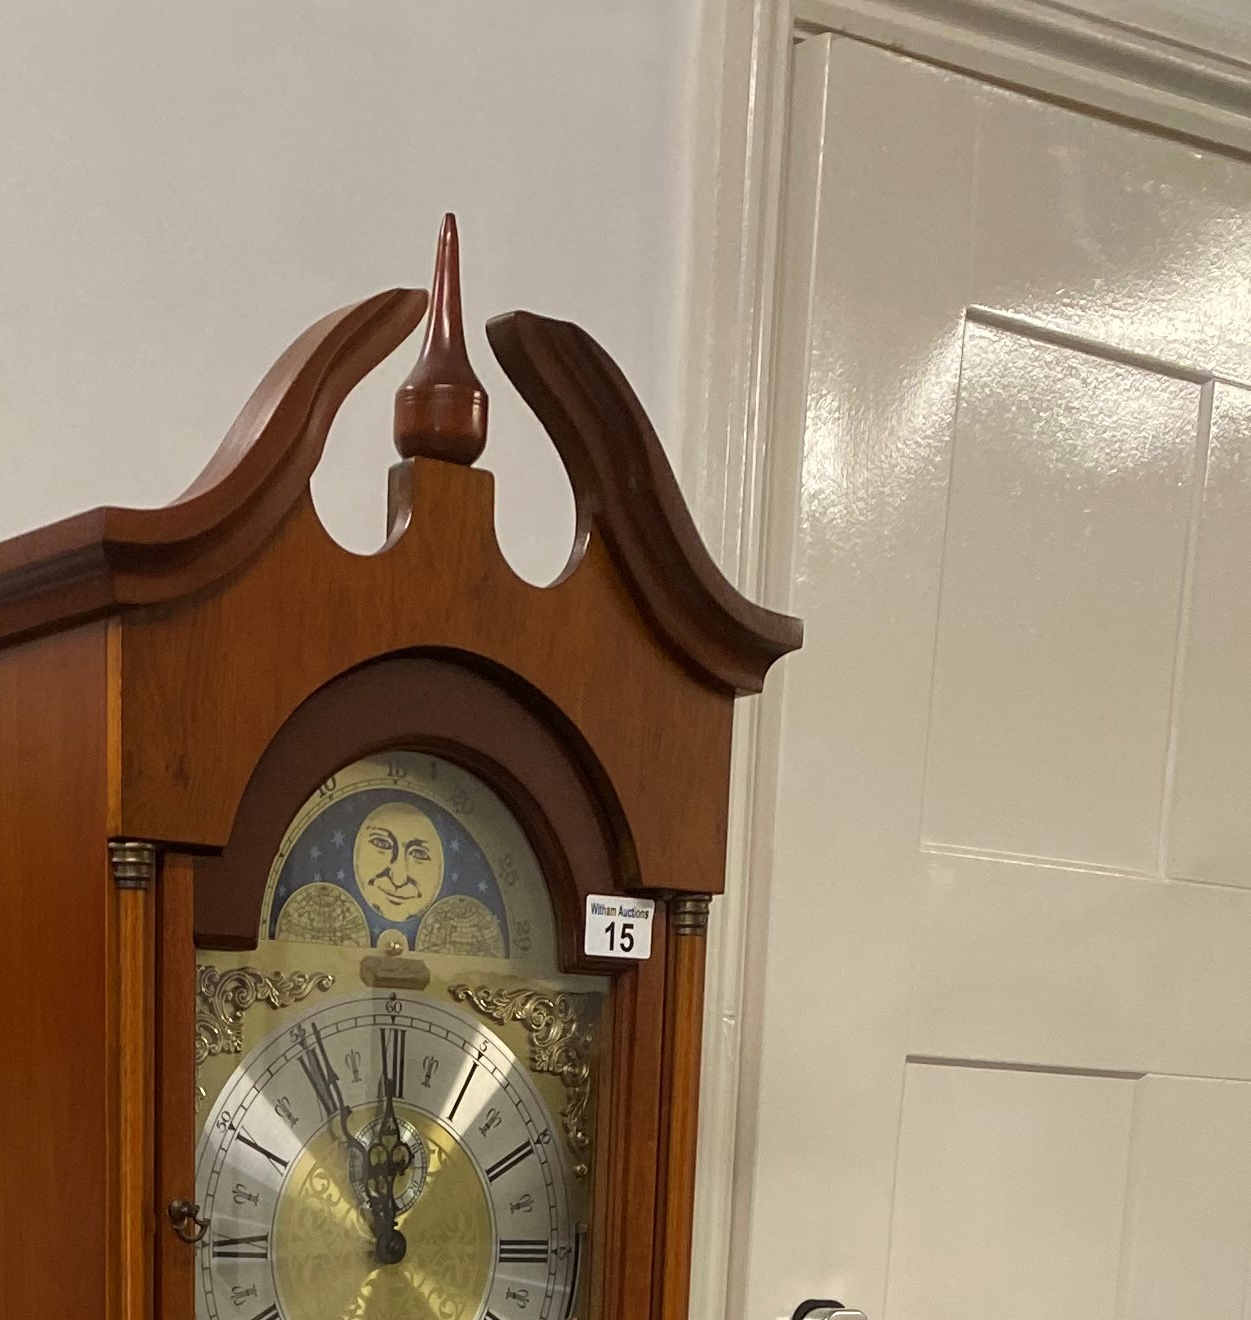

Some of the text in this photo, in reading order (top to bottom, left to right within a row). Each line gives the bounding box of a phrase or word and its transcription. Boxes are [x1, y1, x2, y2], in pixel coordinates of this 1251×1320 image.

[591, 902, 649, 920] Witham Auctions
[605, 921, 635, 953] 15
[385, 1001, 402, 1013] 60
[478, 1039, 488, 1052] 5
[446, 1061, 479, 1123] I
[216, 1111, 232, 1133] 50
[235, 1124, 290, 1177] X
[485, 1139, 535, 1183] II
[212, 1232, 269, 1260] IX
[499, 1239, 549, 1263] III
